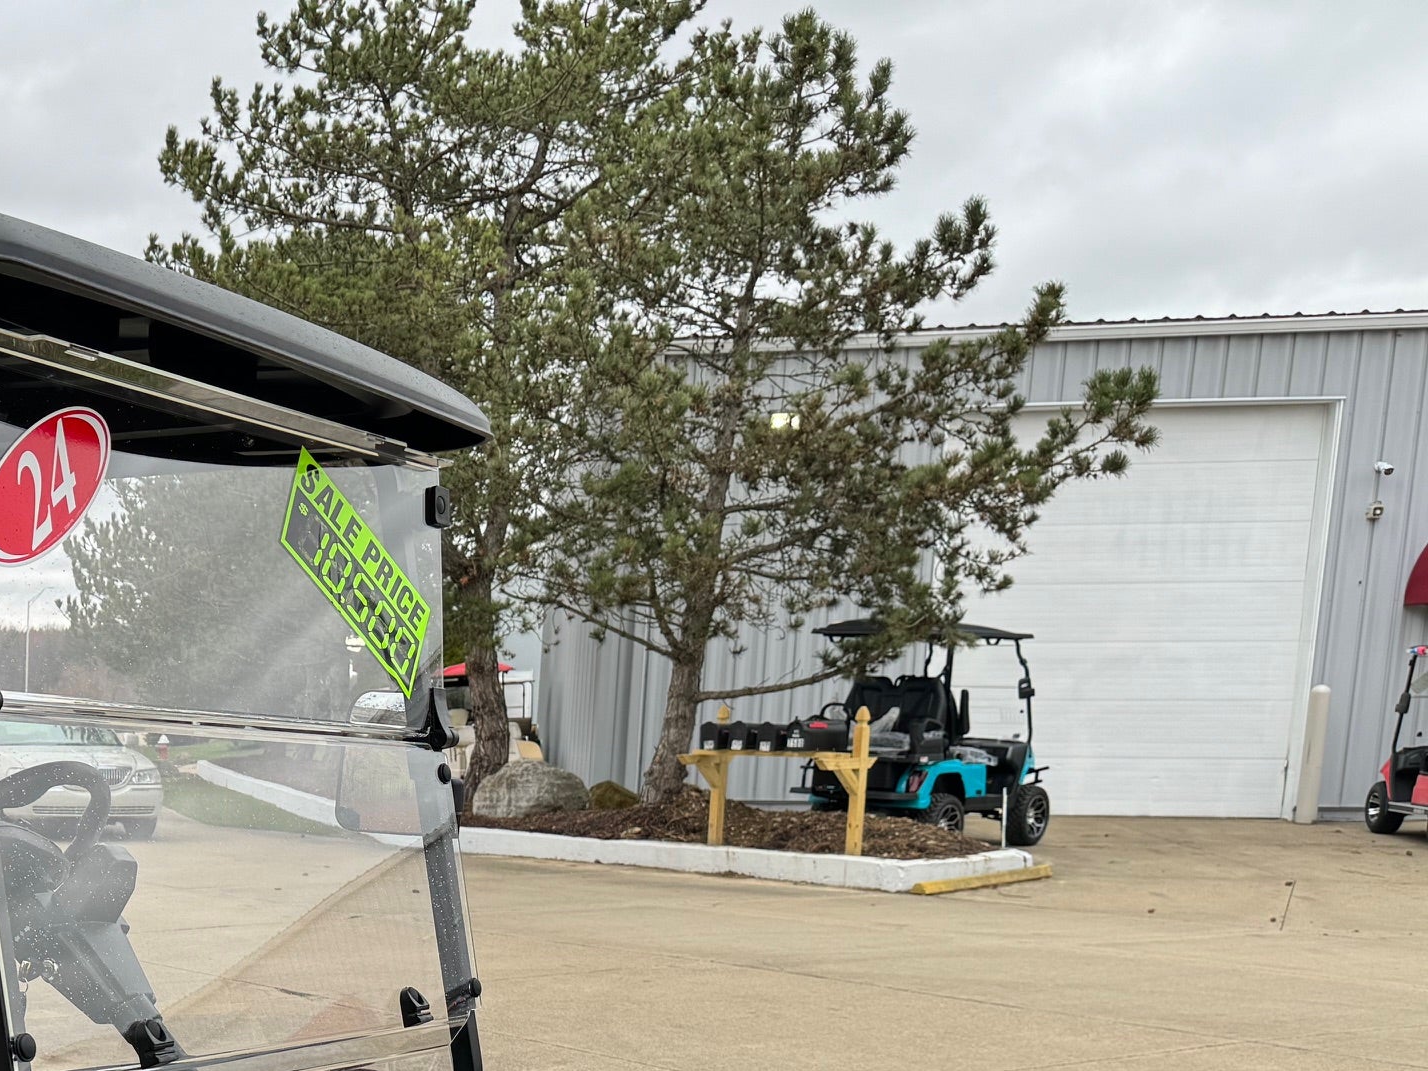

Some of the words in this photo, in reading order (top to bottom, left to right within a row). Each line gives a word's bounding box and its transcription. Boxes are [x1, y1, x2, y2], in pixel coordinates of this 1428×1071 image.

[17, 418, 77, 552] 24
[300, 464, 362, 548] SALE
[361, 539, 425, 631] PRICE
